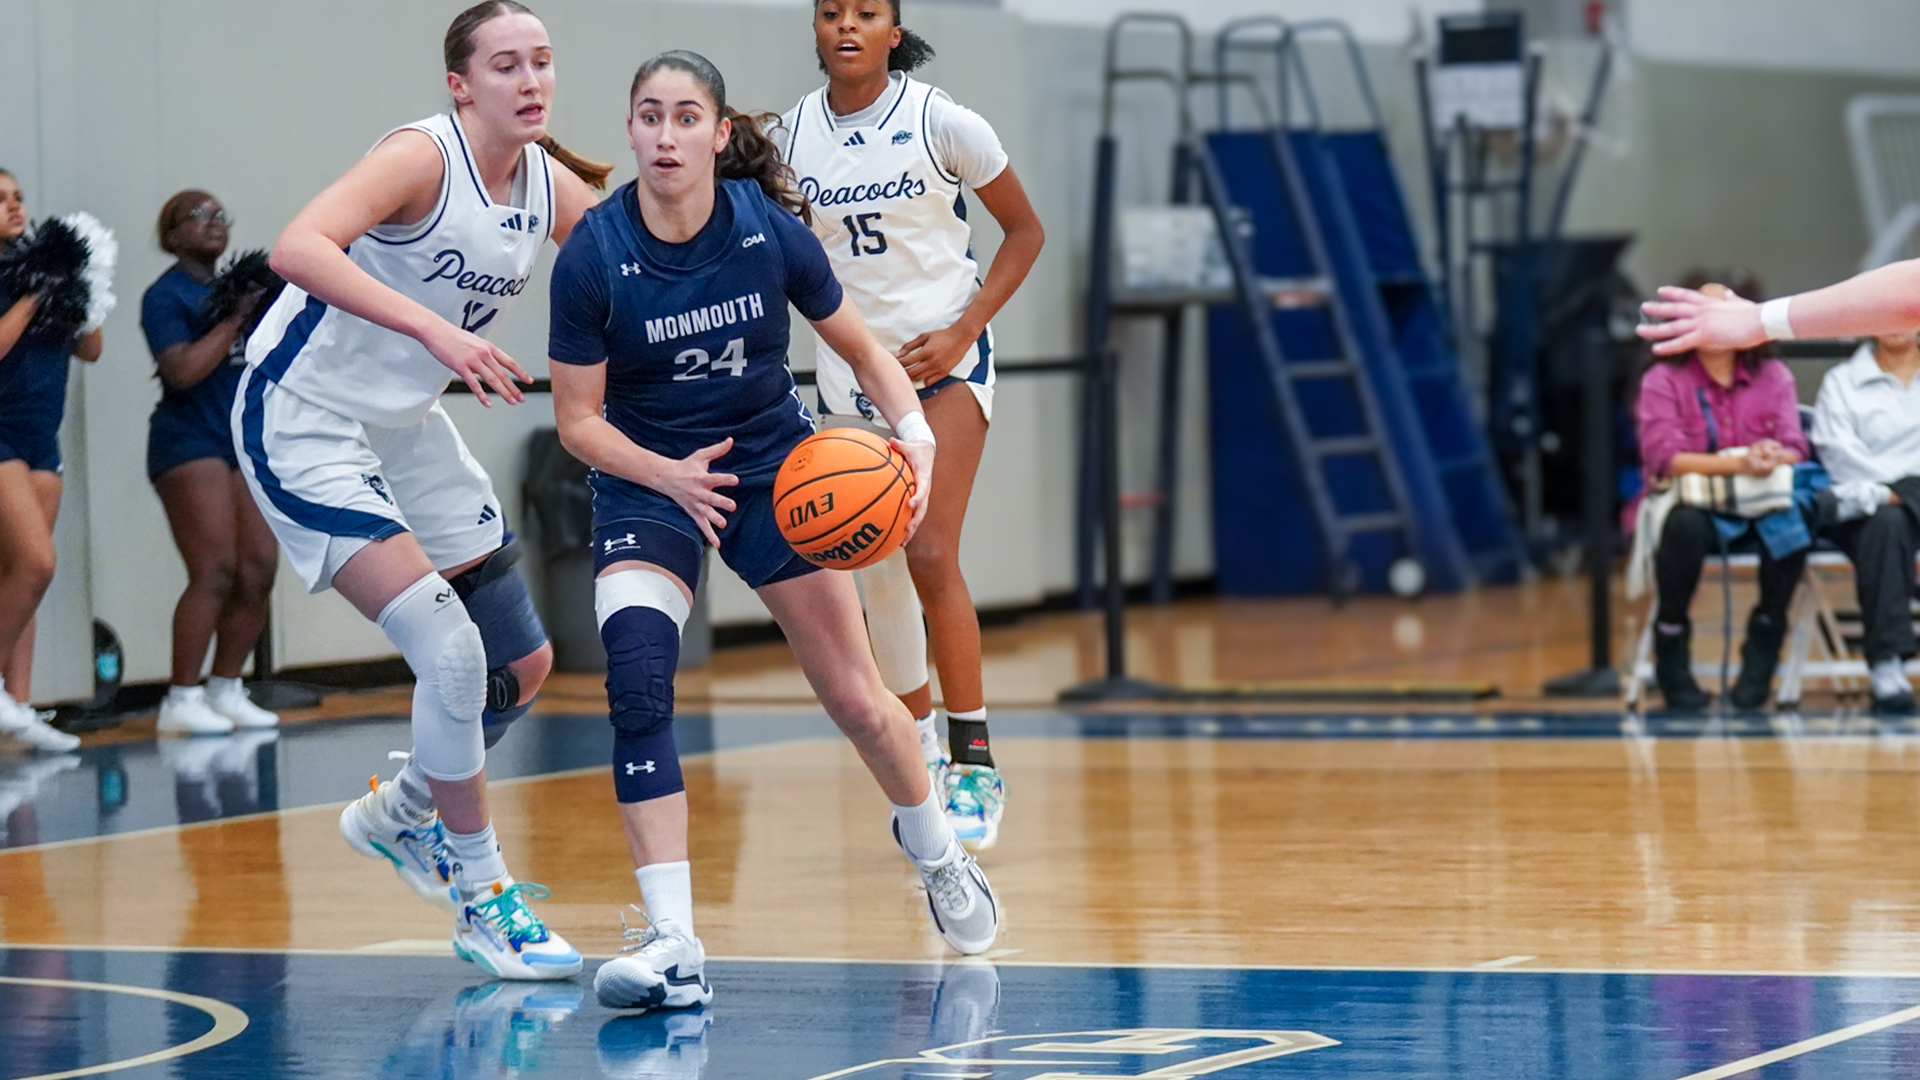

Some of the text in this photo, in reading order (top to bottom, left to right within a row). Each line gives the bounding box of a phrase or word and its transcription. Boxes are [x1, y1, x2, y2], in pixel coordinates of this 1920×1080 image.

[798, 171, 926, 207] Peacocks
[742, 233, 766, 249] CAA
[842, 212, 888, 257] 15
[422, 249, 533, 297] Peacoc
[644, 292, 765, 344] MONMOUTH
[672, 337, 748, 381] 24
